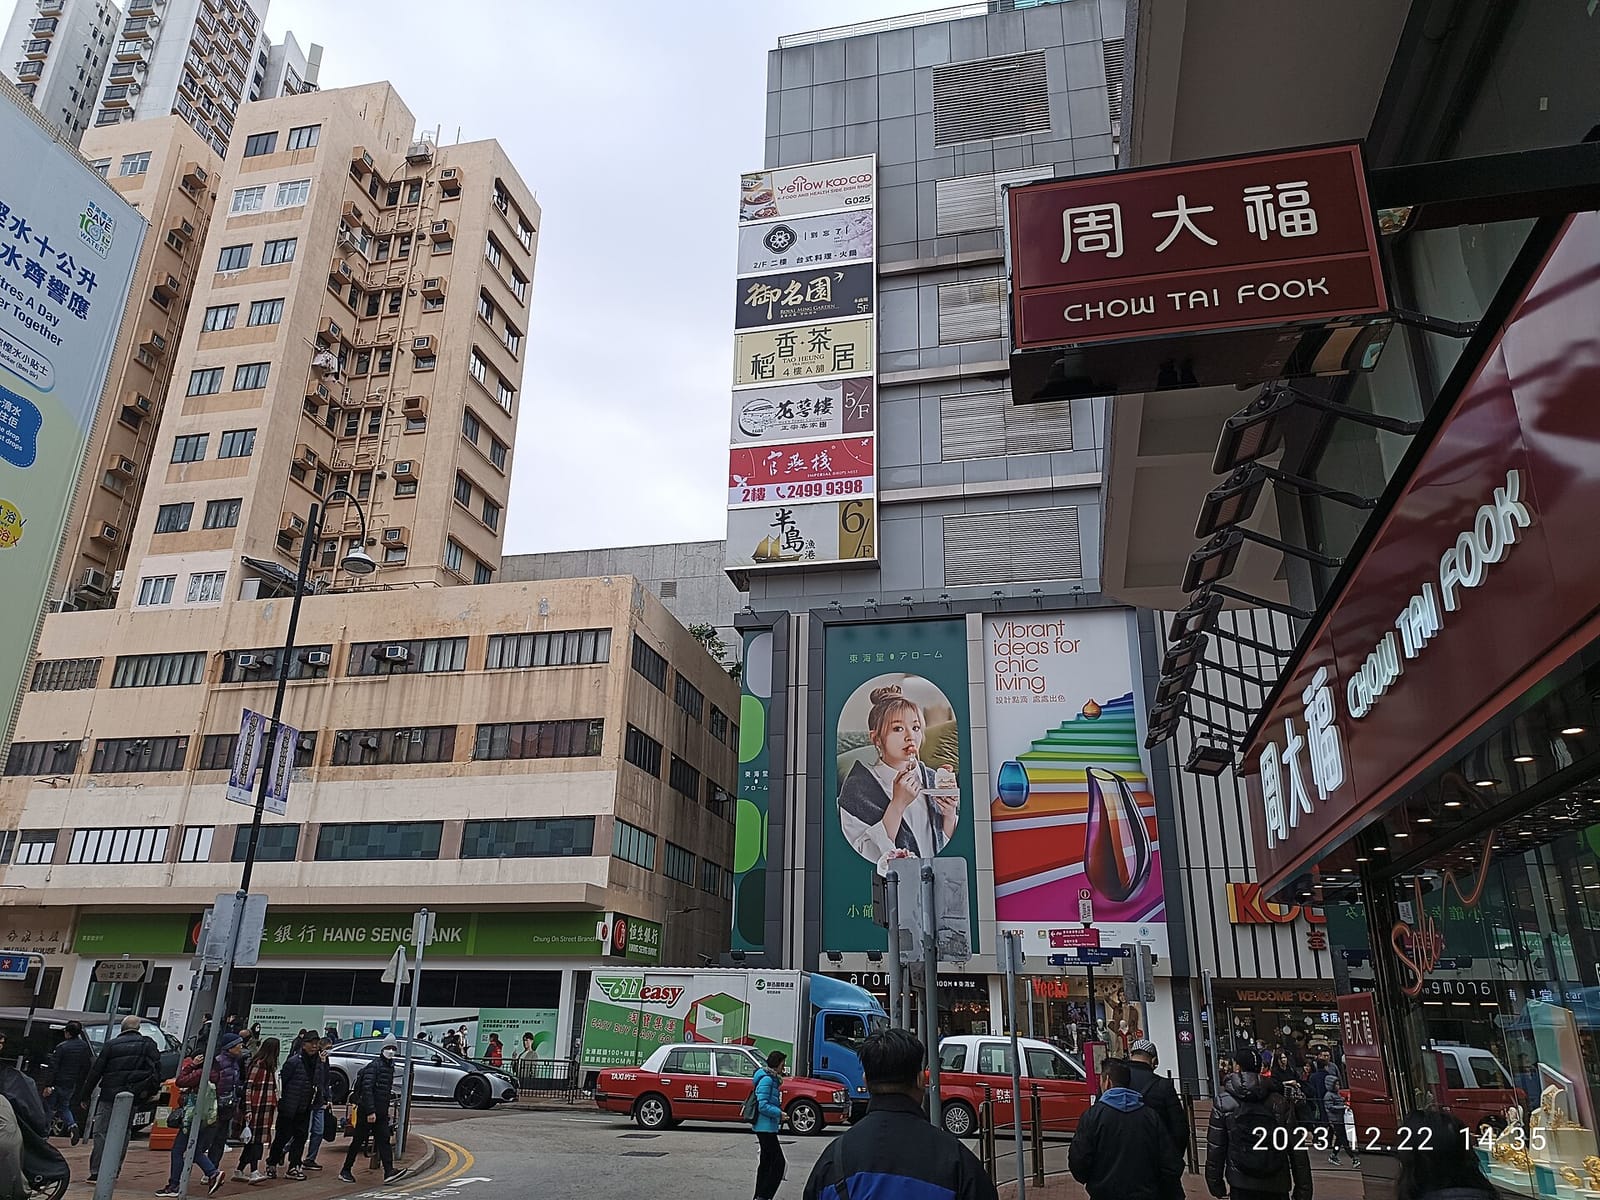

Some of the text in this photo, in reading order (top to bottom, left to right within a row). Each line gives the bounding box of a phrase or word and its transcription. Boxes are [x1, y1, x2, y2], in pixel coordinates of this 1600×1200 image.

[844, 195, 871, 205] G025
[86, 207, 112, 234] SAVE
[1060, 180, 1320, 263] 周大福
[80, 231, 105, 254] WATER
[0, 242, 91, 321] 水齊響應
[744, 275, 832, 320] 御名園
[856, 302, 869, 313] 5F
[1063, 276, 1329, 322] CHOW TAI FOOK
[25, 296, 35, 310] A
[37, 303, 60, 327] Day
[13, 304, 63, 346] Together
[782, 353, 825, 364] TAO HEUNG
[845, 385, 870, 421] 5/F
[762, 450, 832, 476] 官燕棧
[742, 479, 863, 502] 2樓 2499 9398
[770, 508, 805, 552] 半島
[841, 500, 873, 559] 6/F
[1347, 469, 1532, 719] CHOW TAI FOOK
[992, 619, 1065, 639] Vibrant
[993, 637, 1080, 657] ideas for
[994, 656, 1039, 673] chic
[995, 673, 1046, 694] living
[1259, 666, 1347, 849] 周大福
[322, 927, 366, 943] HANG
[370, 927, 412, 943] SENG
[431, 927, 462, 943] ANK
[533, 935, 550, 943] Chung
[1237, 990, 1294, 1001] WELCOME
[591, 1018, 611, 1031] EASY
[613, 1023, 630, 1034] BUY
[632, 1026, 656, 1040] EASY
[1320, 1012, 1341, 1023] 名店
[1343, 1010, 1373, 1045] 周大福
[624, 1073, 637, 1081] 的士
[685, 1090, 699, 1098] TAXI
